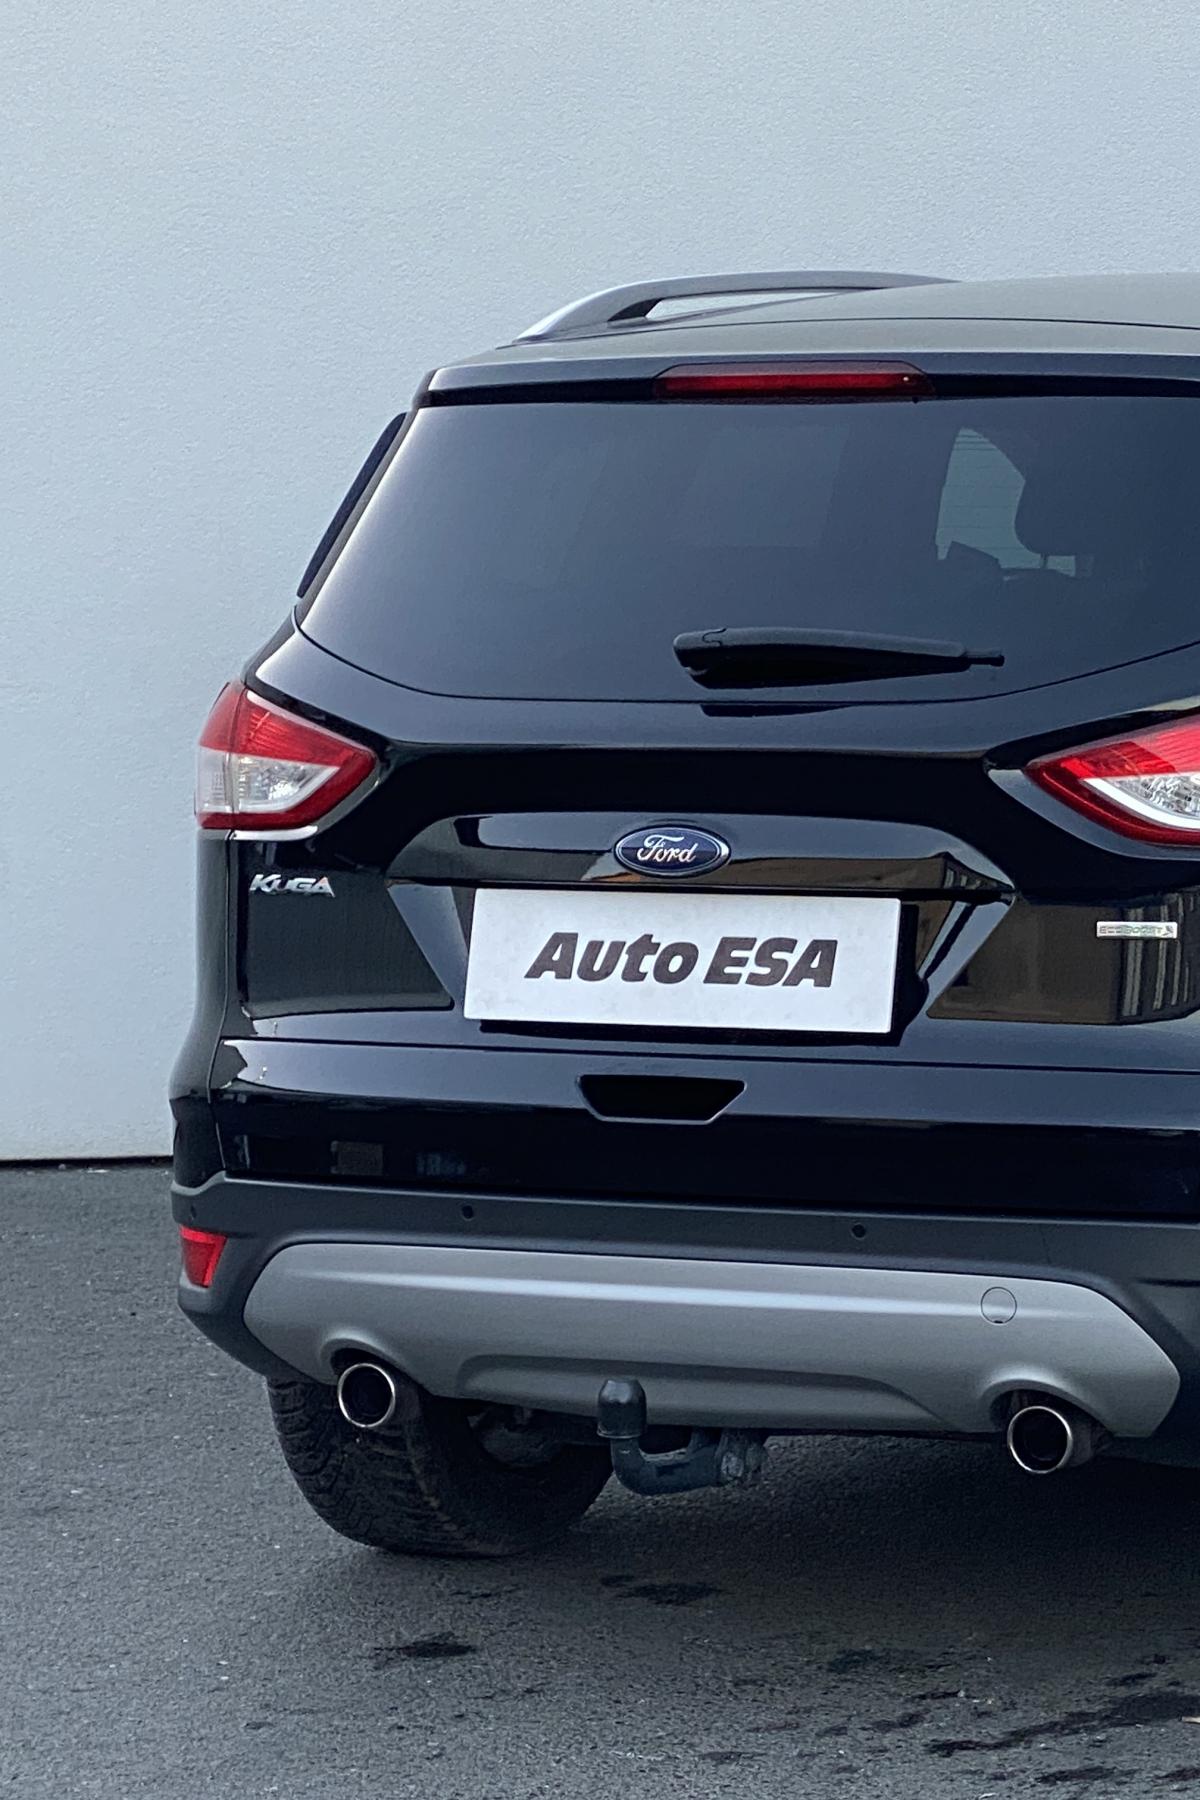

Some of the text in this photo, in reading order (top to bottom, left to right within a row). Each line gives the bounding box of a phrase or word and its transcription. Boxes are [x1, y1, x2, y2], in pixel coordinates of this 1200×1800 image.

[637, 834, 699, 863] Ford
[249, 874, 336, 898] KUGA
[524, 931, 838, 988] Auto ESA
